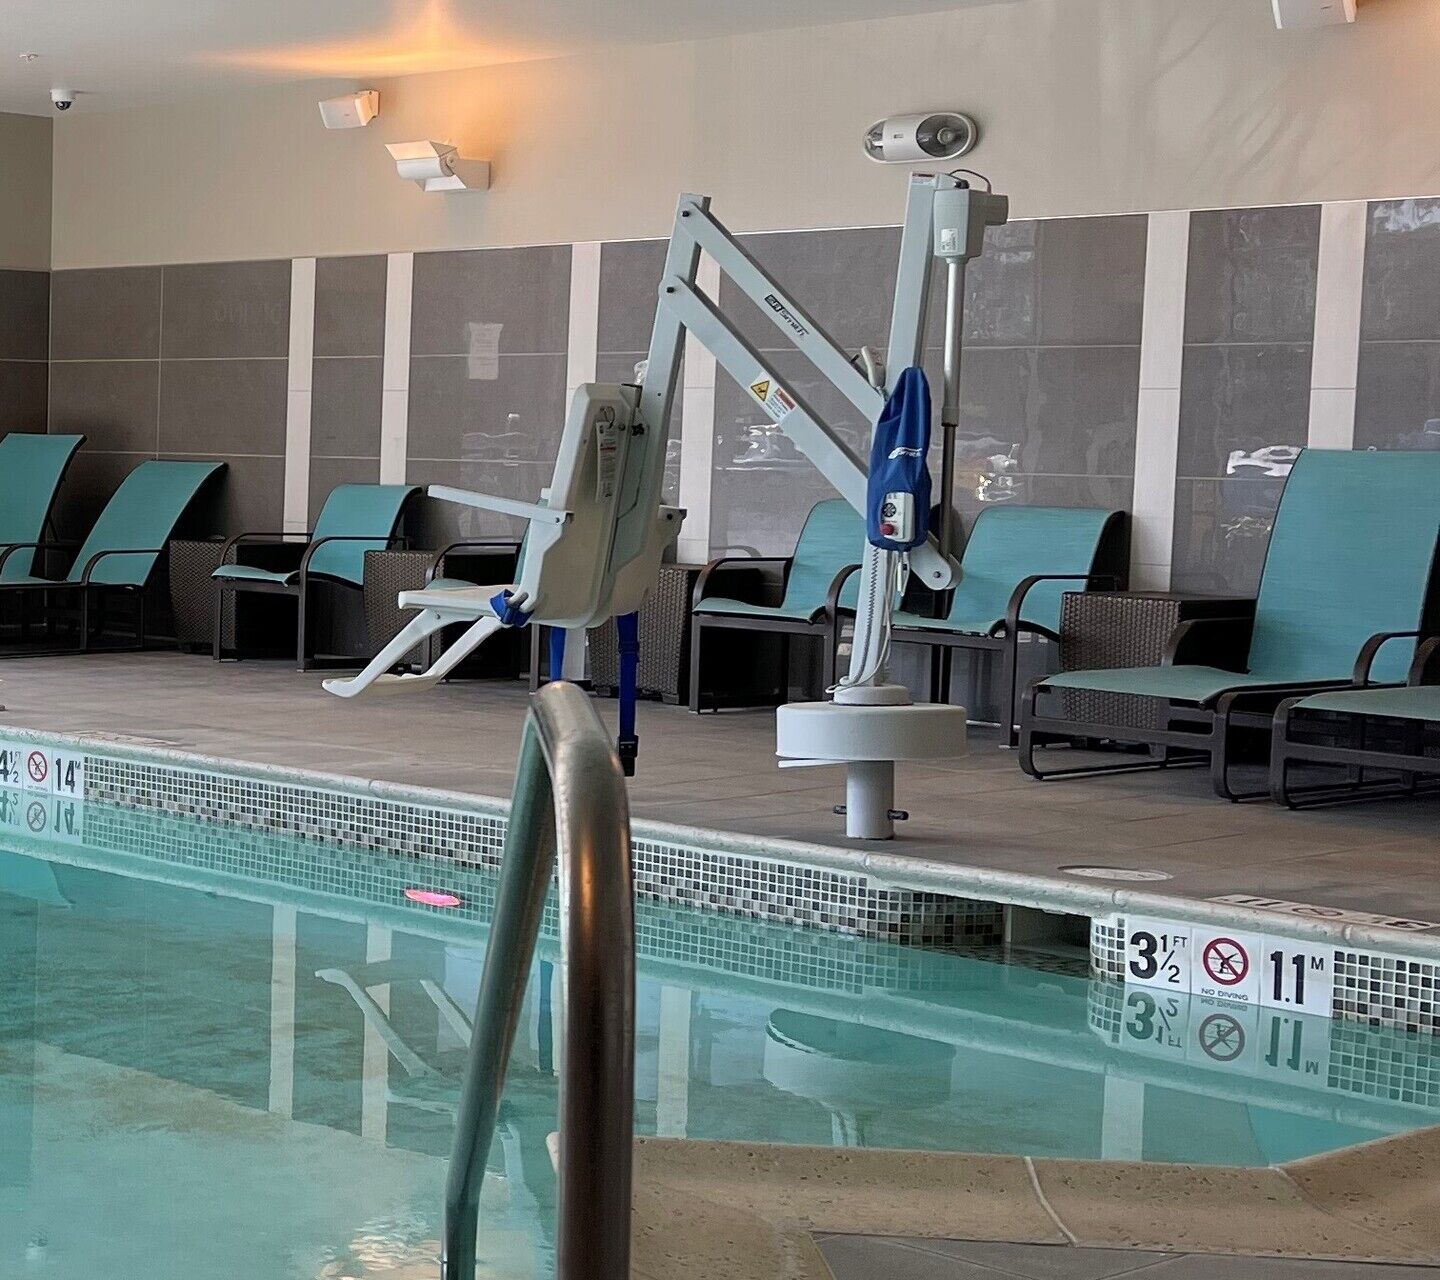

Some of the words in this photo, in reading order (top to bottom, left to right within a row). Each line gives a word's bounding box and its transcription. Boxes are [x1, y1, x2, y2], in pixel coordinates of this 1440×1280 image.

[1173, 936, 1187, 948] FT
[1270, 950, 1305, 1005] 1.1
[1311, 957, 1324, 971] M
[1201, 988, 1216, 996] NO
